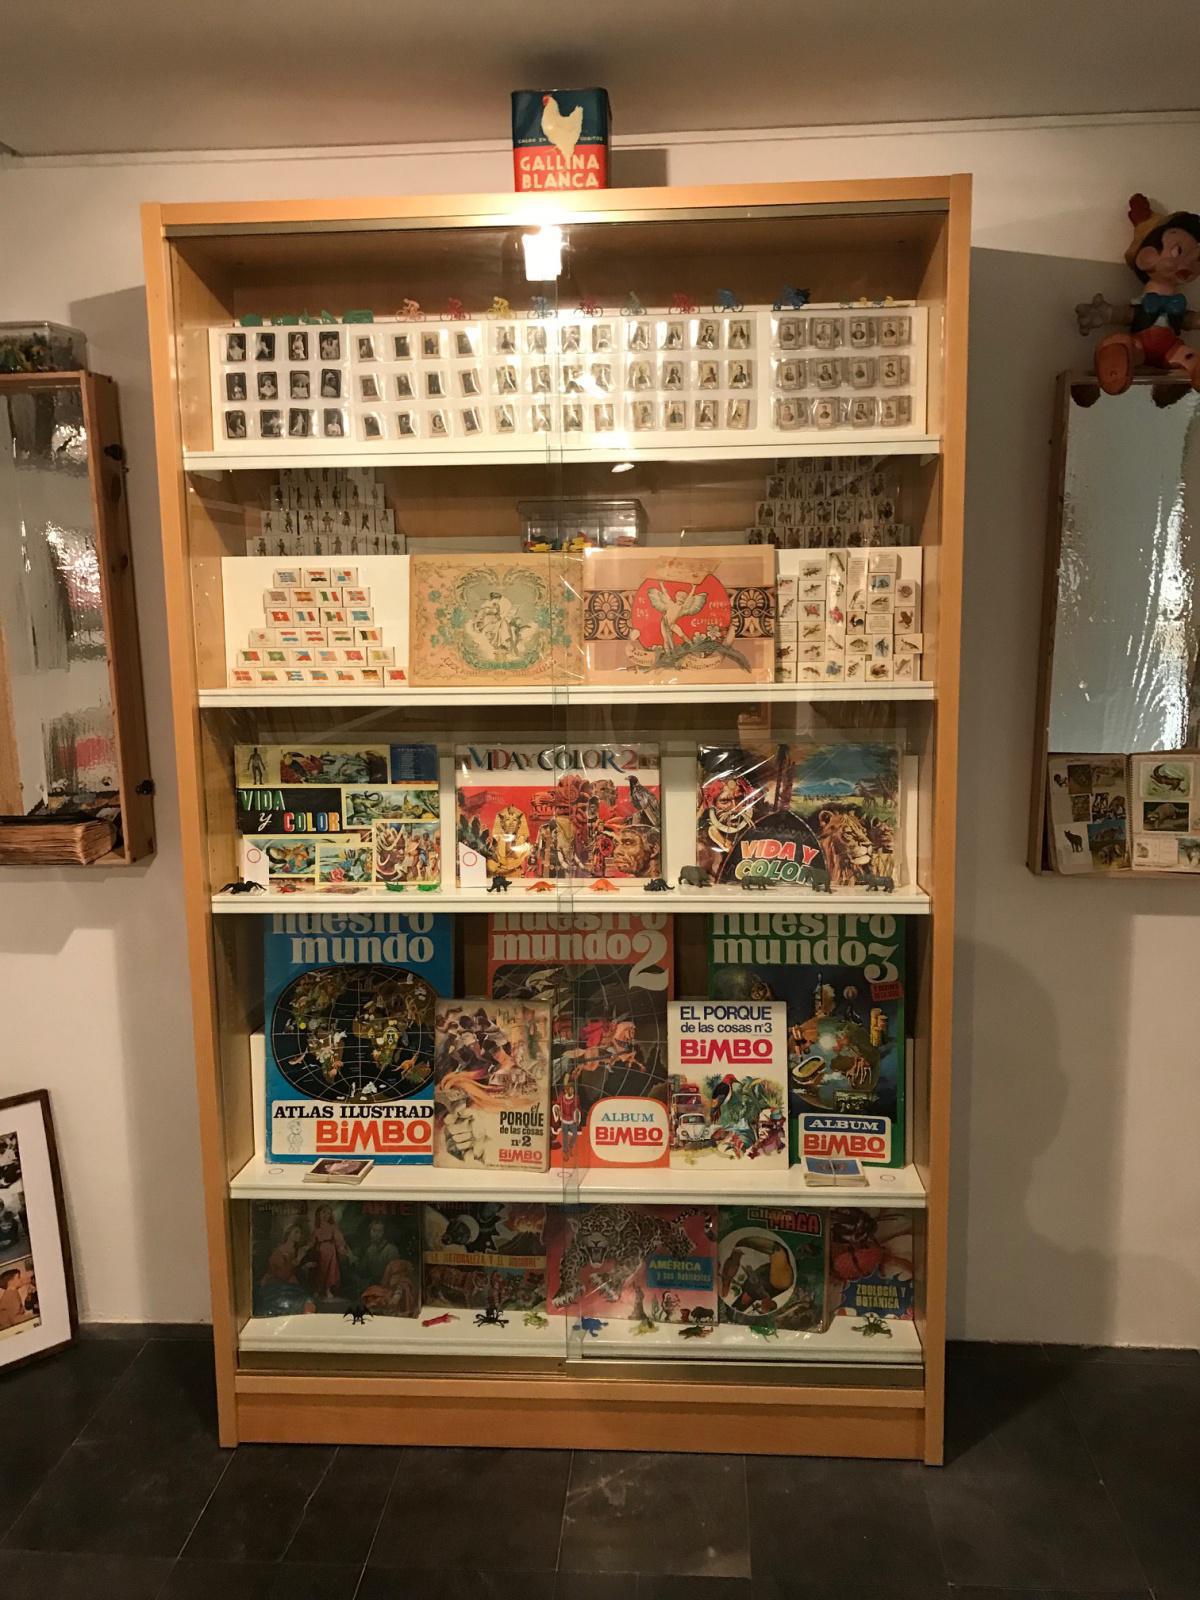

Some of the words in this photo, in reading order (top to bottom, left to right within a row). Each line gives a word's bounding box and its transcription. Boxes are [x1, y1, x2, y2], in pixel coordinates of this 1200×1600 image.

[520, 154, 599, 171] GALLINA
[522, 172, 599, 189] BLANCA
[468, 747, 523, 771] VIDA
[537, 749, 626, 773] COLOR
[621, 749, 638, 770] 2
[239, 790, 286, 811] VIDA
[283, 812, 340, 832] COLOR
[740, 839, 796, 860] VIDA
[801, 844, 819, 865] Y
[713, 914, 896, 938] nuestro
[291, 934, 434, 963] mundo
[493, 930, 632, 961] mundo
[629, 930, 669, 991] 2
[713, 936, 867, 966] mundo
[864, 942, 899, 984] 3
[680, 1006, 700, 1020] EL
[704, 1005, 772, 1020] PORQUE
[681, 1022, 695, 1033] de
[698, 1022, 714, 1033] las
[717, 1024, 752, 1033] cosas
[273, 1106, 334, 1118] ATLAS
[340, 1105, 434, 1119] ILUSTRAD
[500, 1111, 544, 1128] PORQUE
[601, 1112, 654, 1122] ALBUM
[500, 1125, 509, 1134] de
[510, 1125, 521, 1135] las
[522, 1127, 544, 1136] cosas
[809, 1119, 879, 1131] ALBUM
